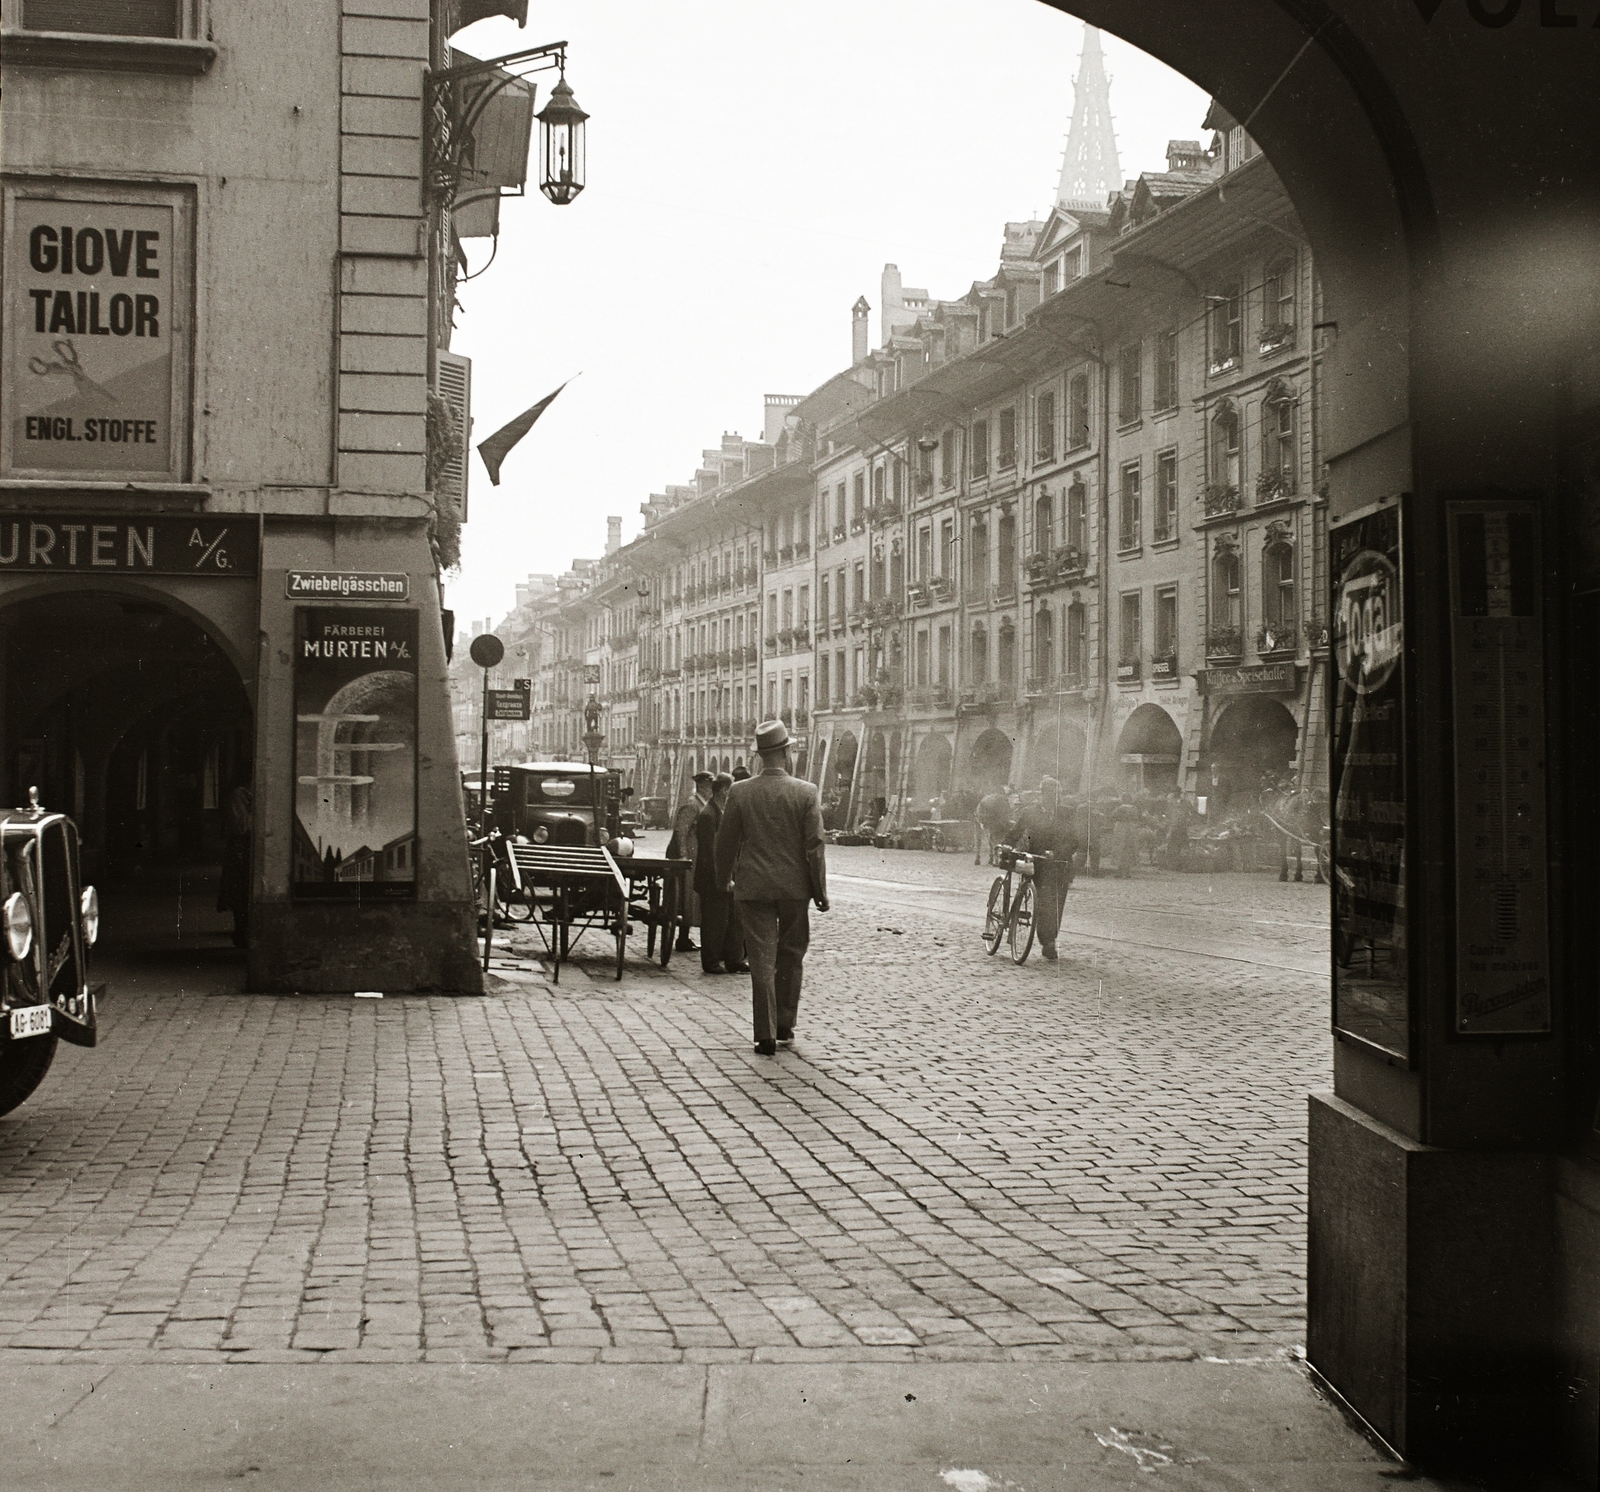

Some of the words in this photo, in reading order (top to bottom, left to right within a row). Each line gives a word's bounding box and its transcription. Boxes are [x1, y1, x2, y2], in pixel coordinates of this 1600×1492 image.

[29, 224, 160, 279] GIOVE
[28, 288, 160, 338] TAILOR
[292, 574, 403, 595] Zwiebelgässchen
[324, 624, 385, 636] FÄRBEREI
[304, 640, 387, 658] MURTEN
